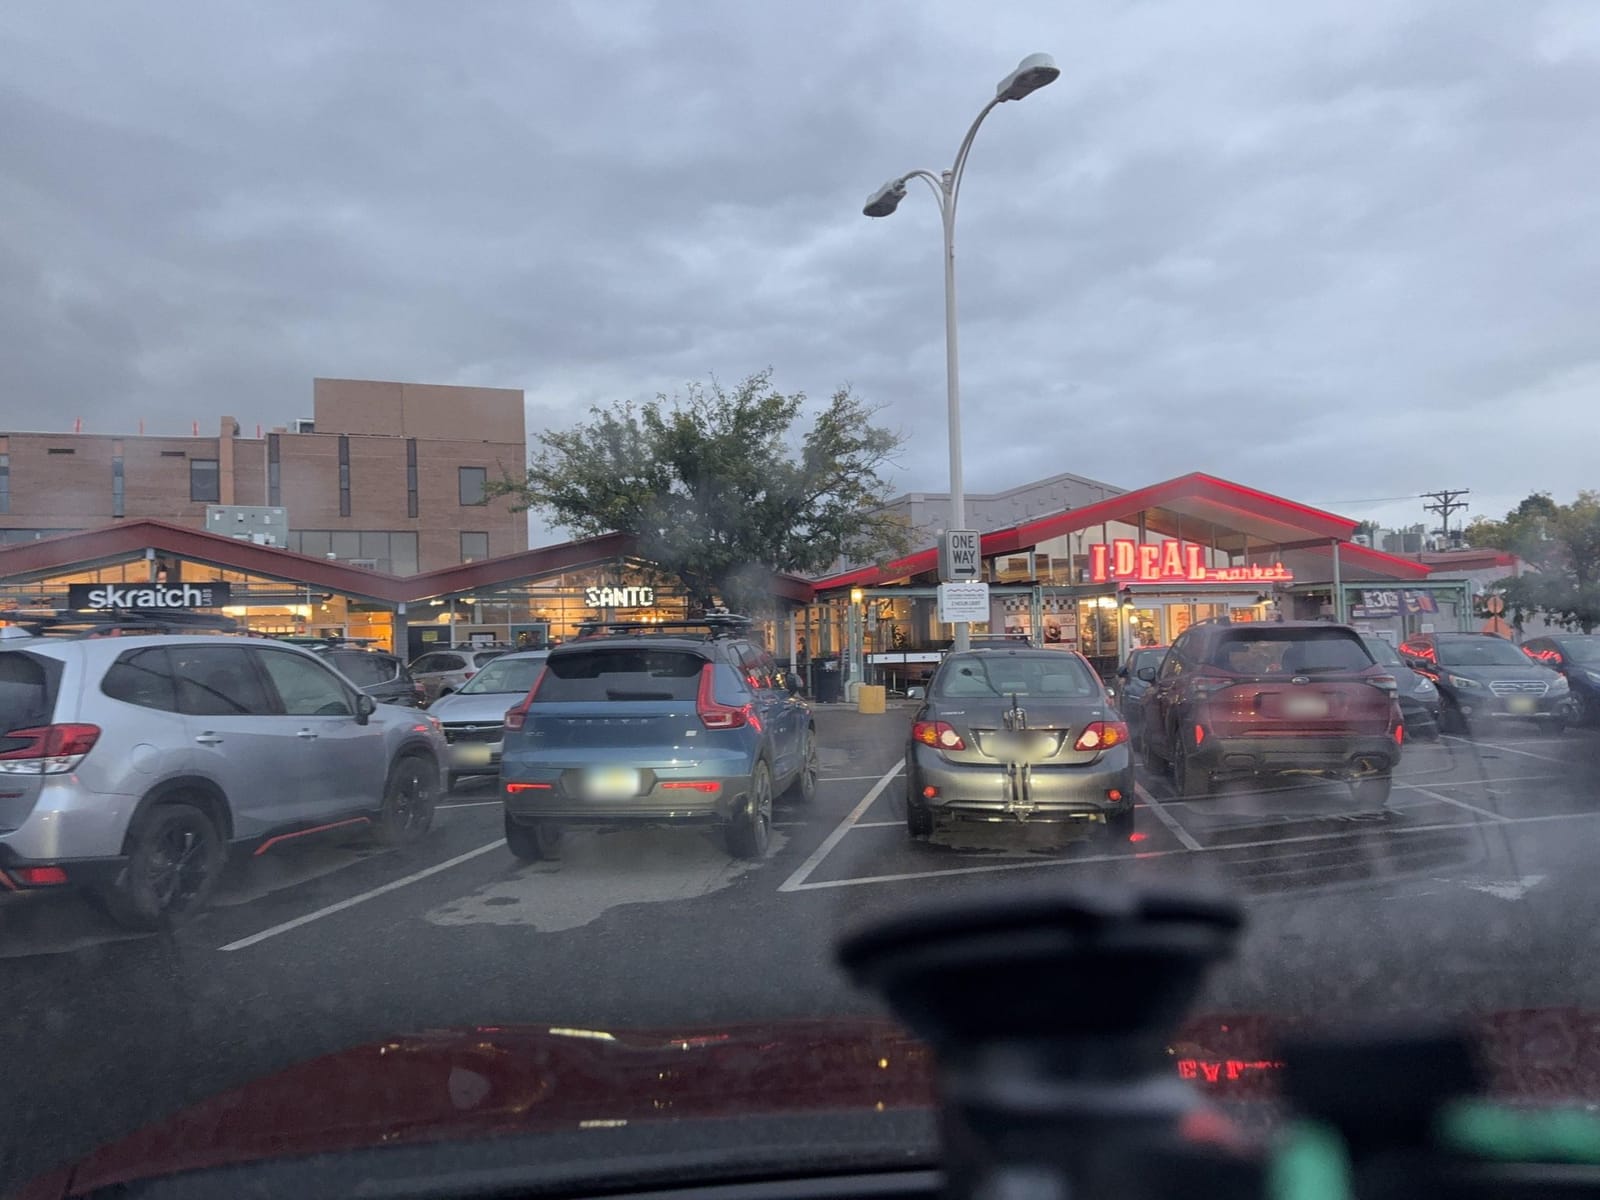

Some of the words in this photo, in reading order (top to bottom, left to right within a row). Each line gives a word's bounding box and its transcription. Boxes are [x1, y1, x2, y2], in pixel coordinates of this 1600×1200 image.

[952, 535, 975, 548] ONE
[952, 550, 976, 564] WAY
[1093, 541, 1206, 580] IDEAL
[88, 584, 202, 608] skratch
[585, 586, 654, 607] SANTO
